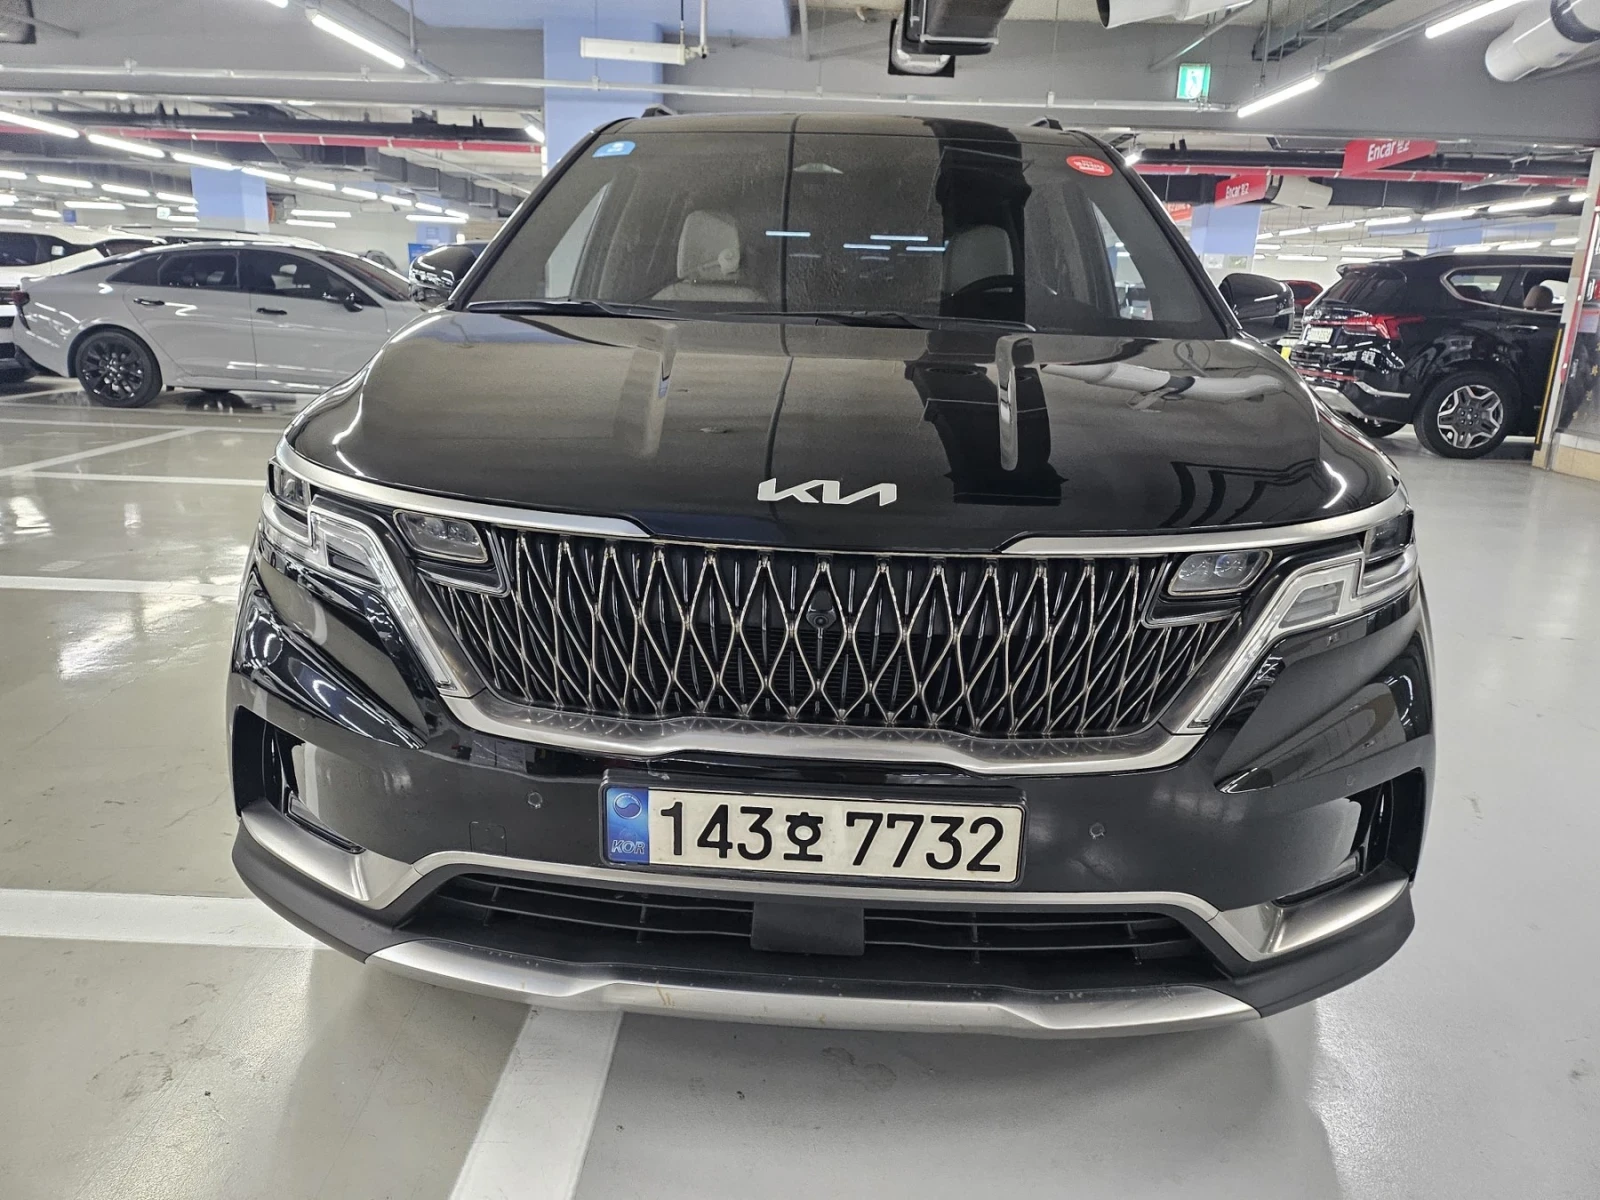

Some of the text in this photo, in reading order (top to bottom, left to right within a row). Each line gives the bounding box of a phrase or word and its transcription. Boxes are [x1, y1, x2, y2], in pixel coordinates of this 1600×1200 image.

[1367, 141, 1397, 162] Encar
[611, 839, 646, 855] KOR
[660, 801, 1006, 873] 143호 7732
